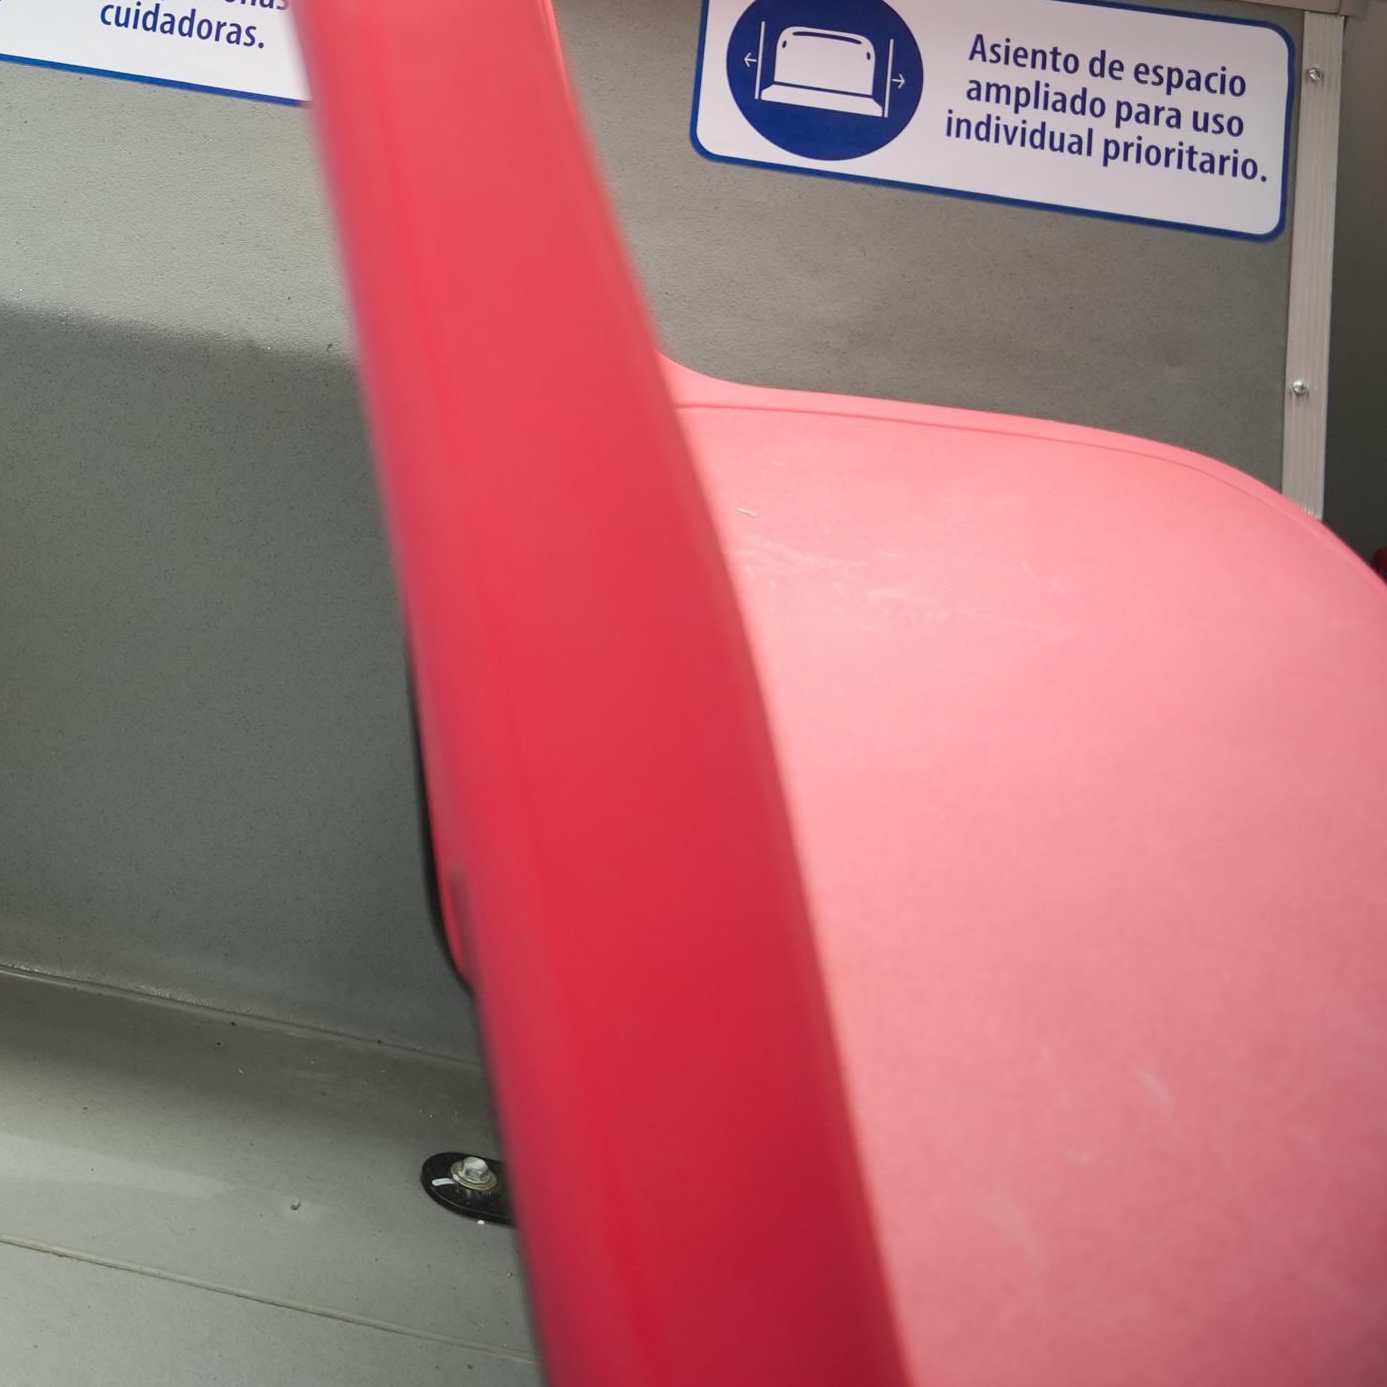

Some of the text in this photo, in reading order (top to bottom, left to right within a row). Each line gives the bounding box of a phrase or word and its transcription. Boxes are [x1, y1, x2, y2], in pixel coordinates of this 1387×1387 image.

[99, 0, 266, 49] cuidadoras.
[968, 33, 1247, 97] Asiento de espacio
[966, 78, 1245, 138] ampliado para uso
[945, 108, 1268, 183] individual prioritario.
